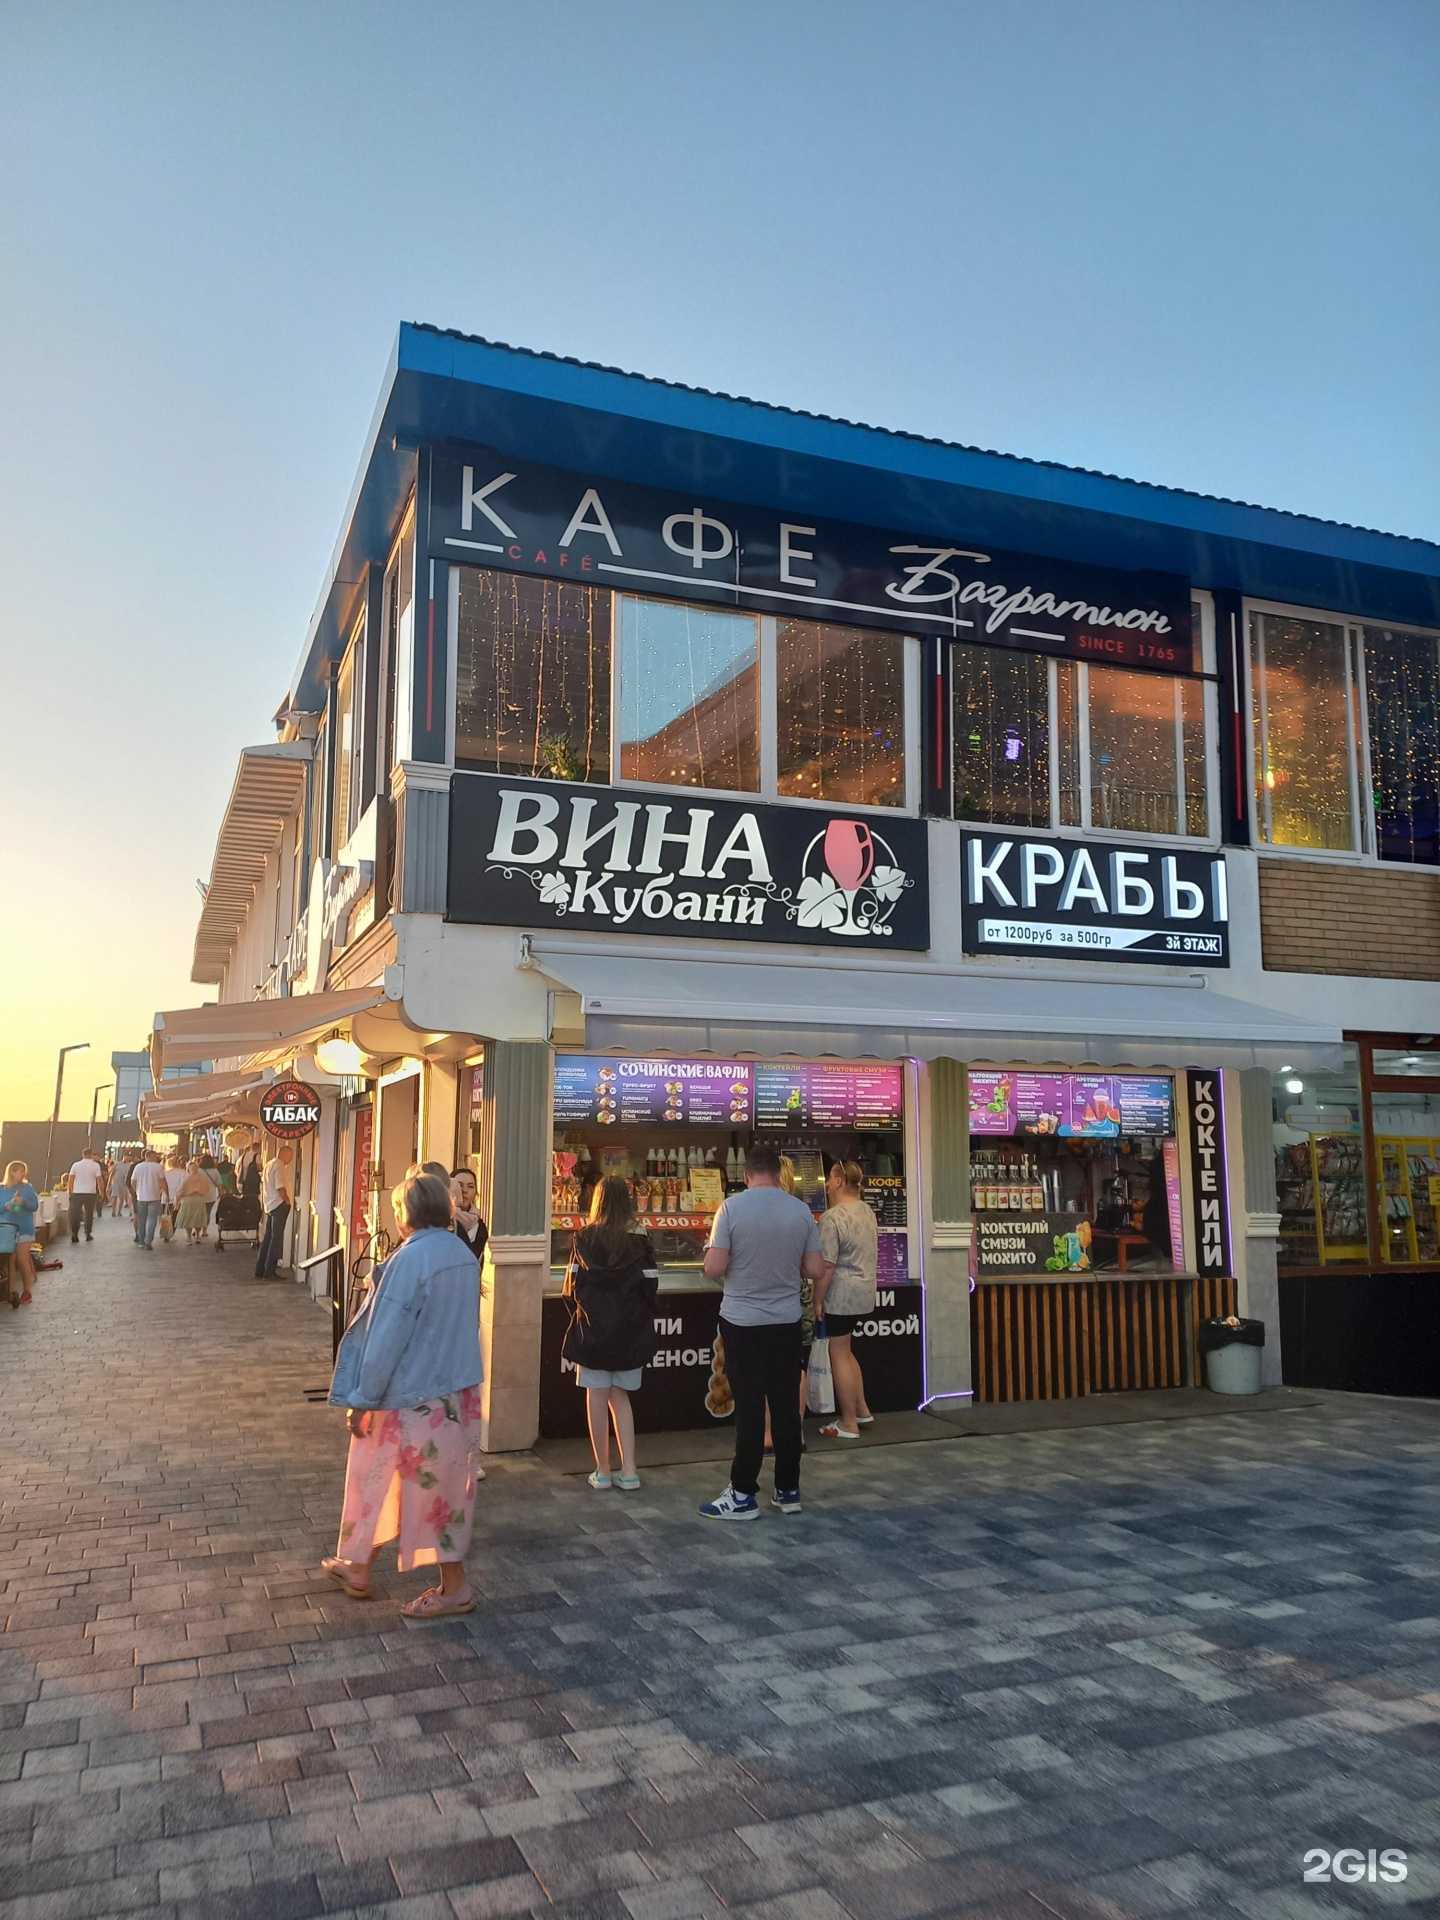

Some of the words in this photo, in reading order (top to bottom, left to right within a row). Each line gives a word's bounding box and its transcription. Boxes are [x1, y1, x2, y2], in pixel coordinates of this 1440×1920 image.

[461, 465, 816, 587] КАФЕ
[508, 545, 592, 571] CAFÉ
[885, 544, 1173, 634] Багратион
[1078, 635, 1125, 653] SINCE
[1138, 644, 1176, 661] 1765
[486, 789, 773, 882] ВИНА
[967, 838, 1229, 922] КРАБЫ
[569, 870, 767, 924] Кубани
[987, 928, 1001, 938] от
[1004, 926, 1053, 943] 1200руб
[1060, 932, 1073, 943] за
[1077, 930, 1112, 947] 500гр
[1183, 937, 1218, 952] ЭТАЖ
[618, 1062, 704, 1078] СОЧИНСКИЕ
[706, 1064, 749, 1079] ВАФЛИ
[263, 1106, 319, 1122] ТАБАК
[868, 1177, 902, 1188] КОФЕ
[981, 1237, 1026, 1249] СМУЗИ
[981, 1252, 1037, 1265] МОХИТО
